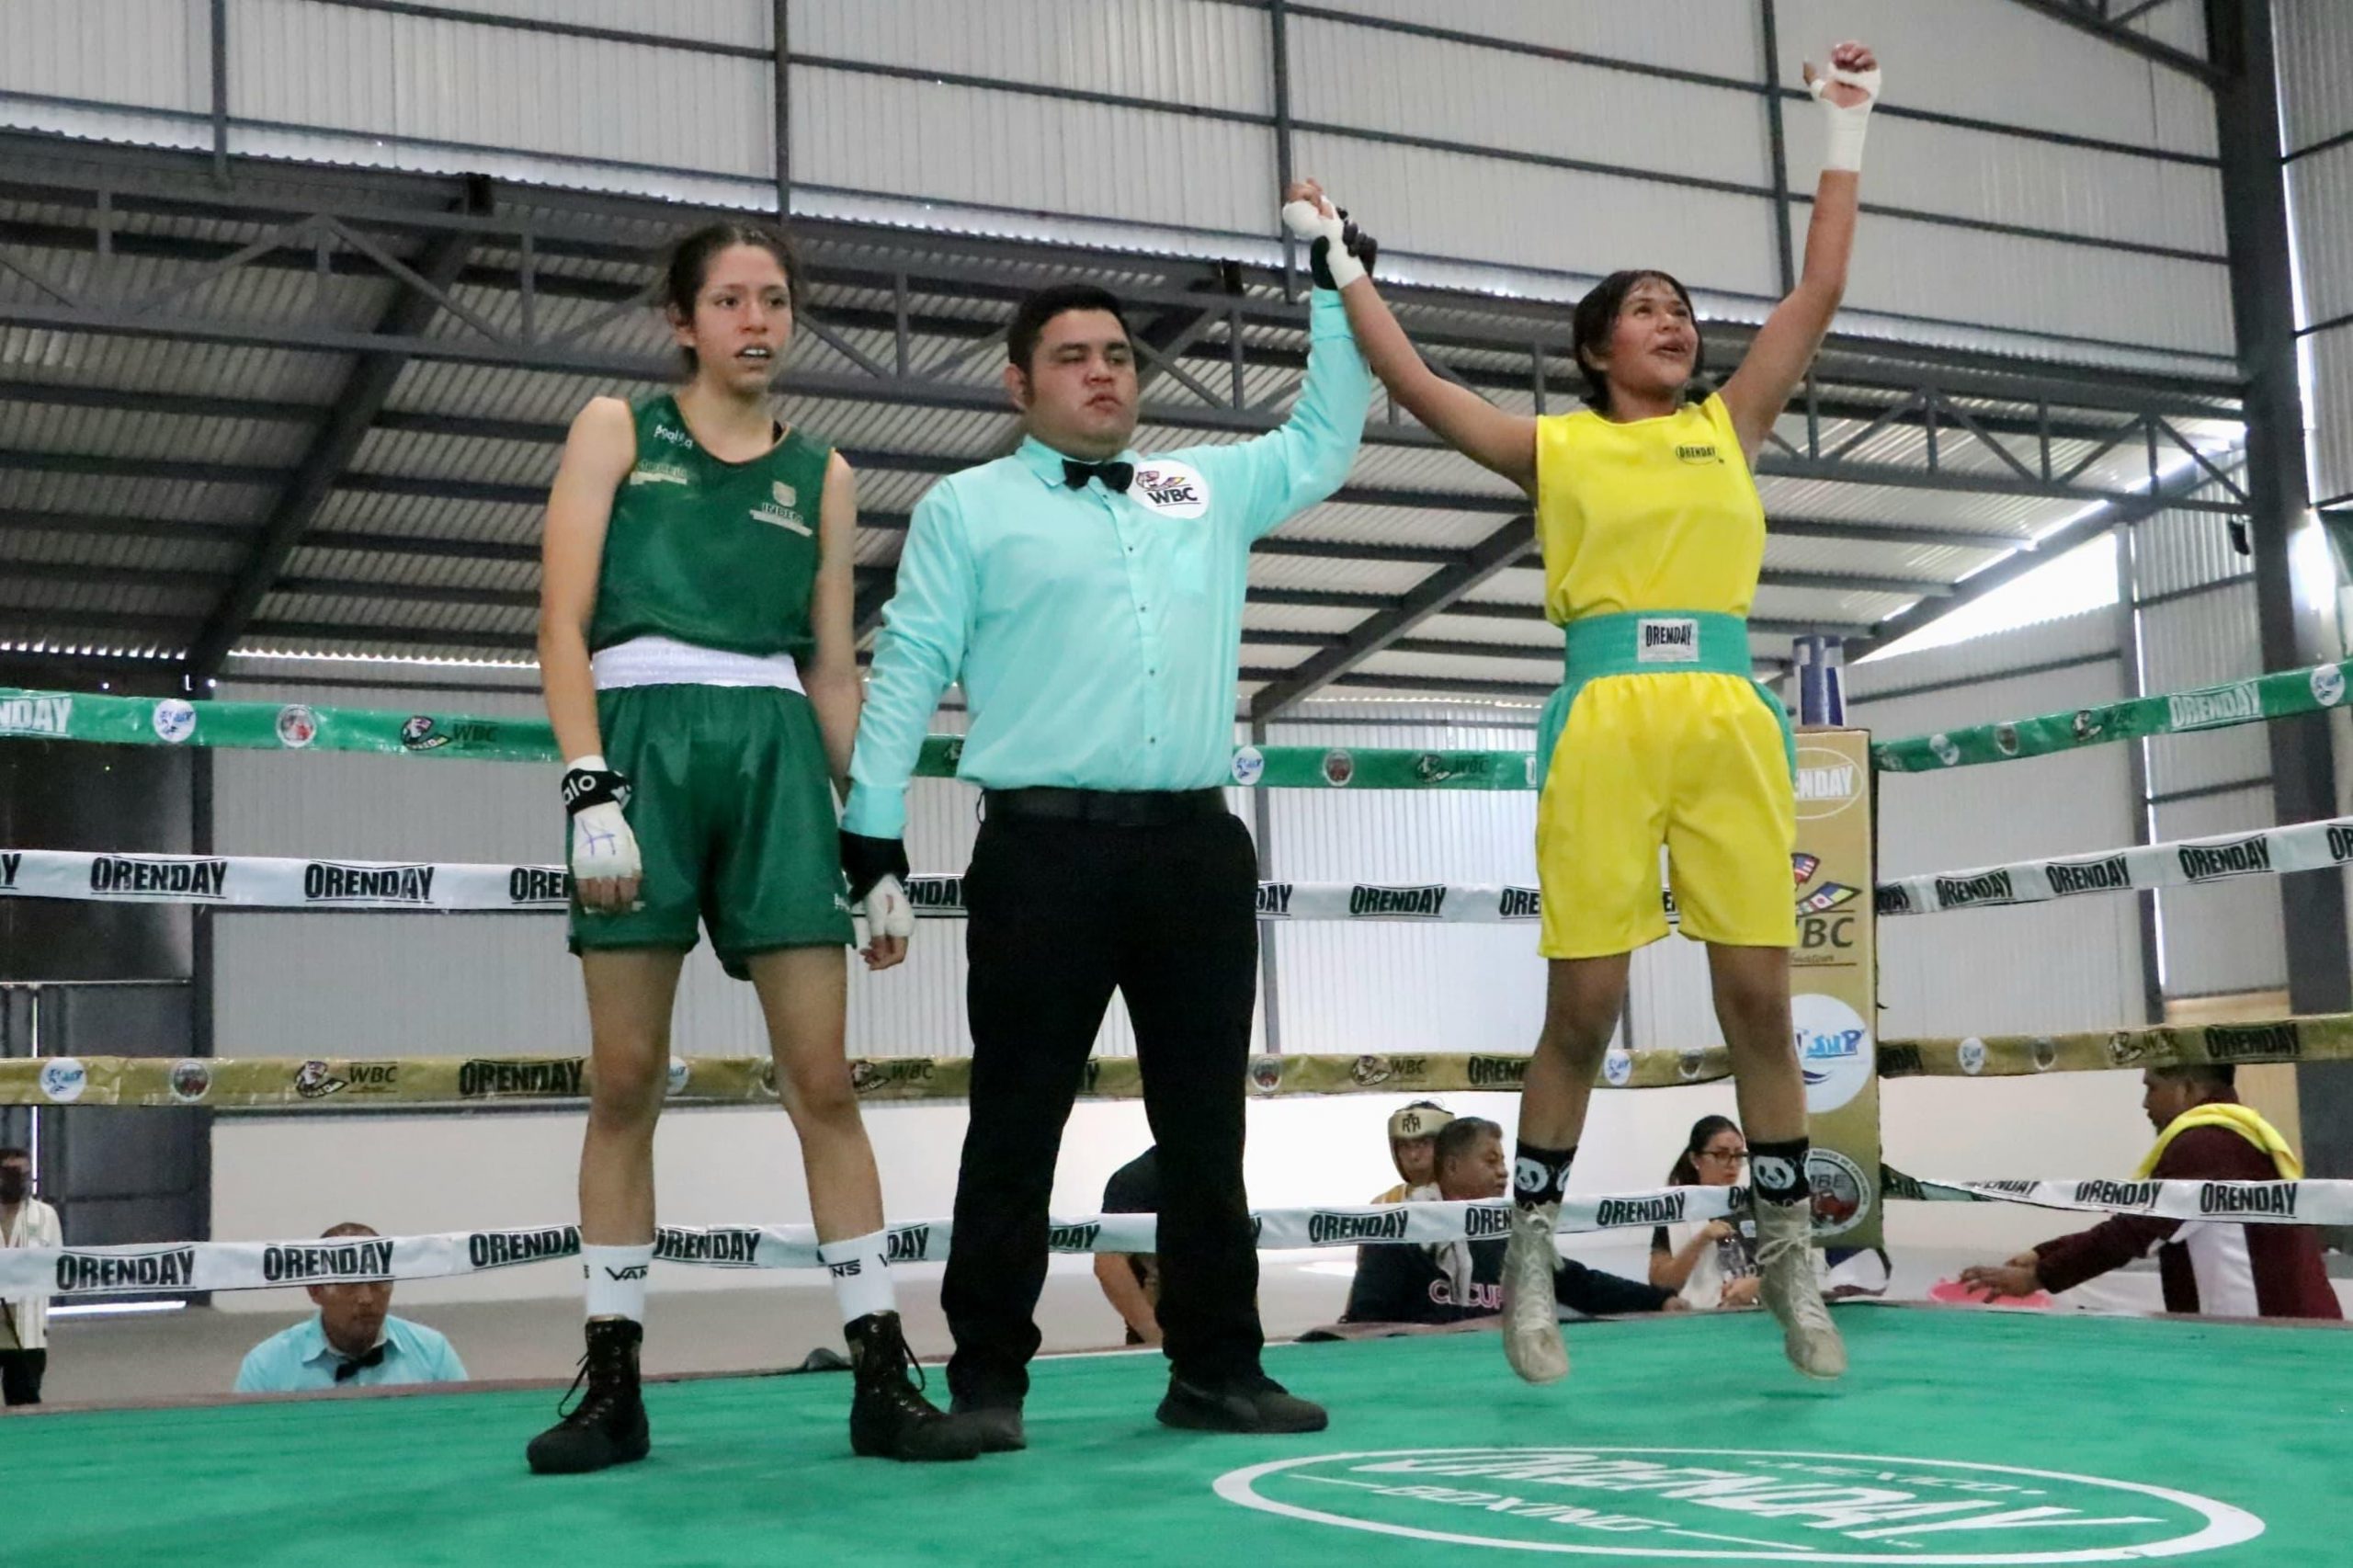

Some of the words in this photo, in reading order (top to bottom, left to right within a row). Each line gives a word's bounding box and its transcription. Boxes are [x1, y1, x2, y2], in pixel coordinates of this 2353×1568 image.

[1147, 486, 1198, 505] WBC
[1645, 624, 1691, 647] ORENDAY
[2168, 682, 2261, 728] ORENDAY
[1795, 765, 1853, 799] NDAY
[90, 857, 228, 895] ORENDAY
[2045, 856, 2131, 894] ORENDAY
[2178, 837, 2270, 880] ORENDAY
[304, 863, 435, 901] ORENDAY
[1935, 870, 2014, 907] ORENDAY
[1349, 885, 1447, 915] ORENDAY
[1796, 917, 1854, 948] BC
[349, 1066, 397, 1084] WBC
[460, 1060, 584, 1096] ORENDAY
[891, 1062, 934, 1080] WBC
[1391, 1059, 1427, 1074] WBC
[1597, 1192, 1685, 1226] ORENDAY
[2075, 1180, 2162, 1209] ORENDAY
[2200, 1182, 2297, 1214] ORENDAY
[1309, 1210, 1408, 1243] ORENDAY
[264, 1241, 394, 1280] ORENDAY
[470, 1227, 581, 1267] ORENDA
[56, 1251, 195, 1290] ORENDAY
[1349, 1452, 2166, 1540] ORENDAY
[1371, 1485, 1679, 1531] BOXING
